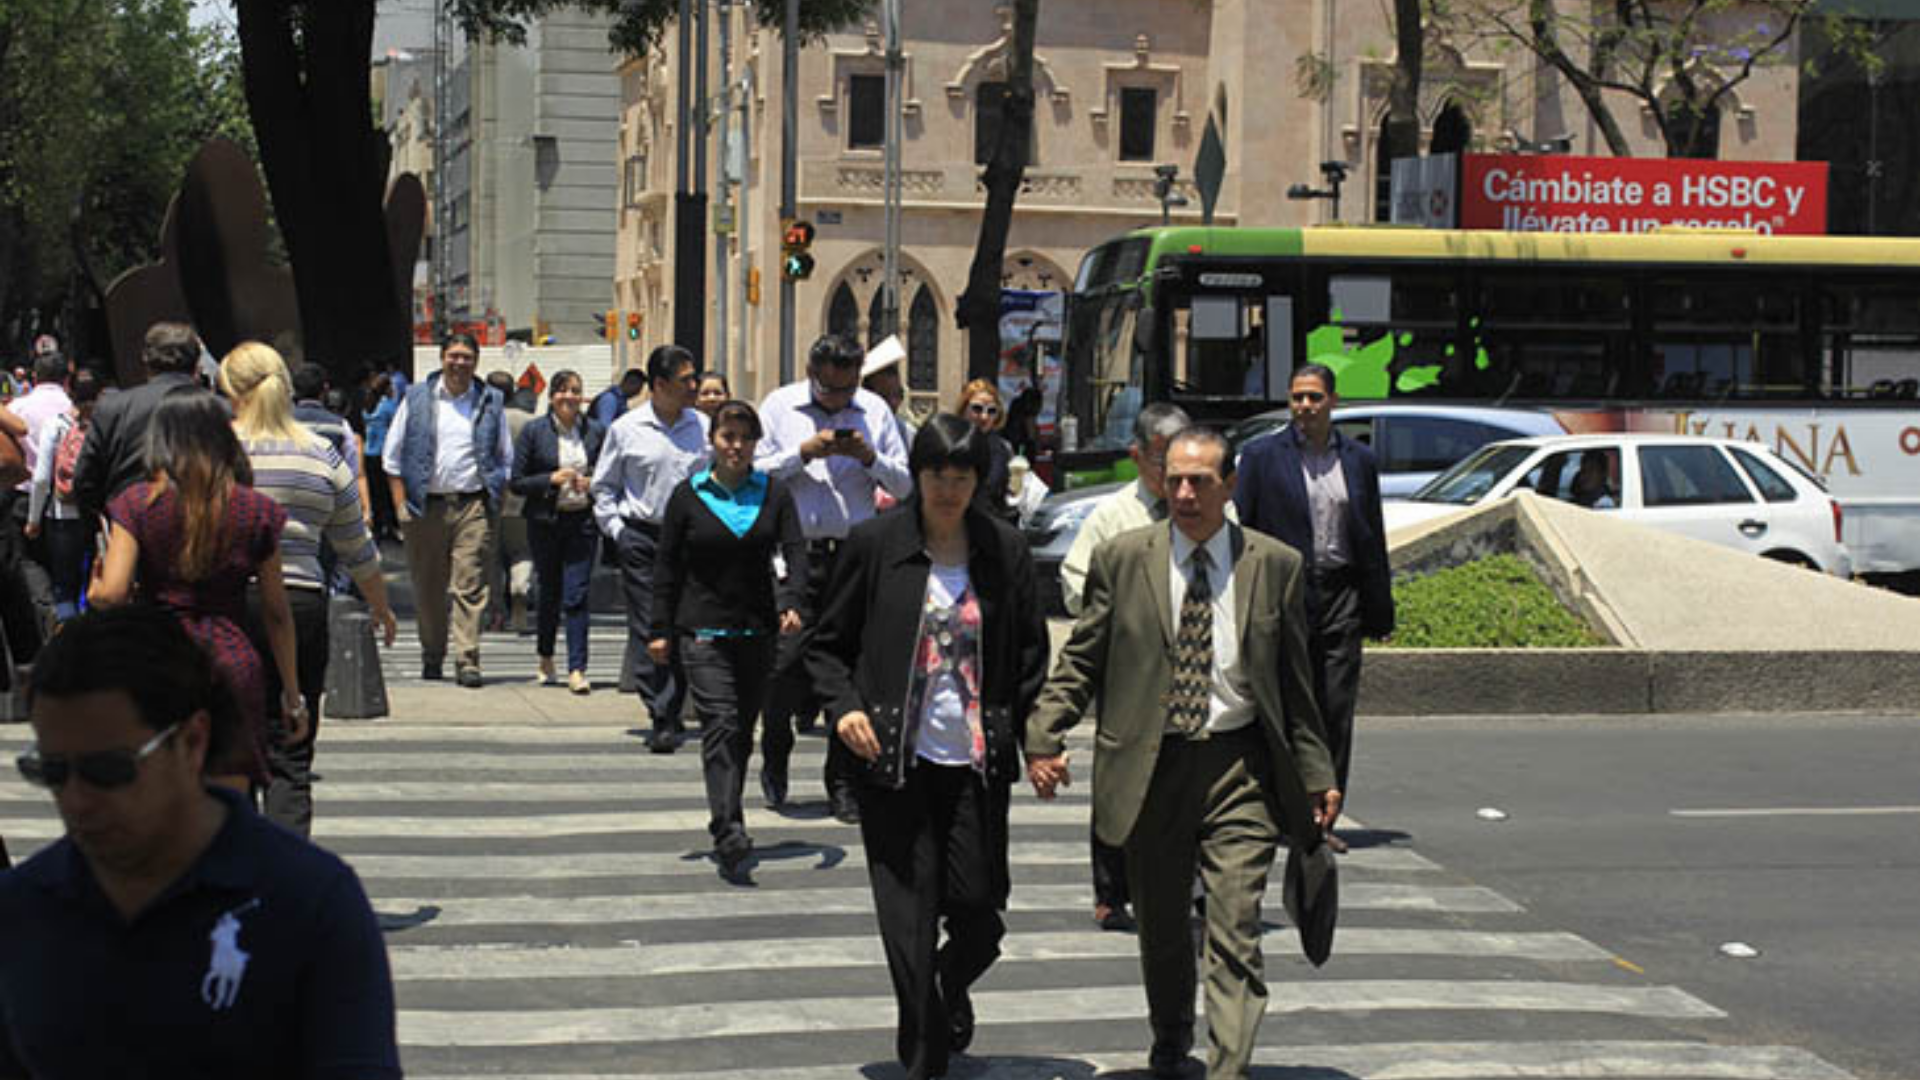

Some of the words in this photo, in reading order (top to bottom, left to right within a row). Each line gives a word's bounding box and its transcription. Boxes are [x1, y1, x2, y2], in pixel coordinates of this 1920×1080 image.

[1484, 169, 1644, 205] Cámbiate
[1652, 182, 1671, 206] a
[1681, 174, 1776, 208] HSBC
[1784, 186, 1805, 216] y
